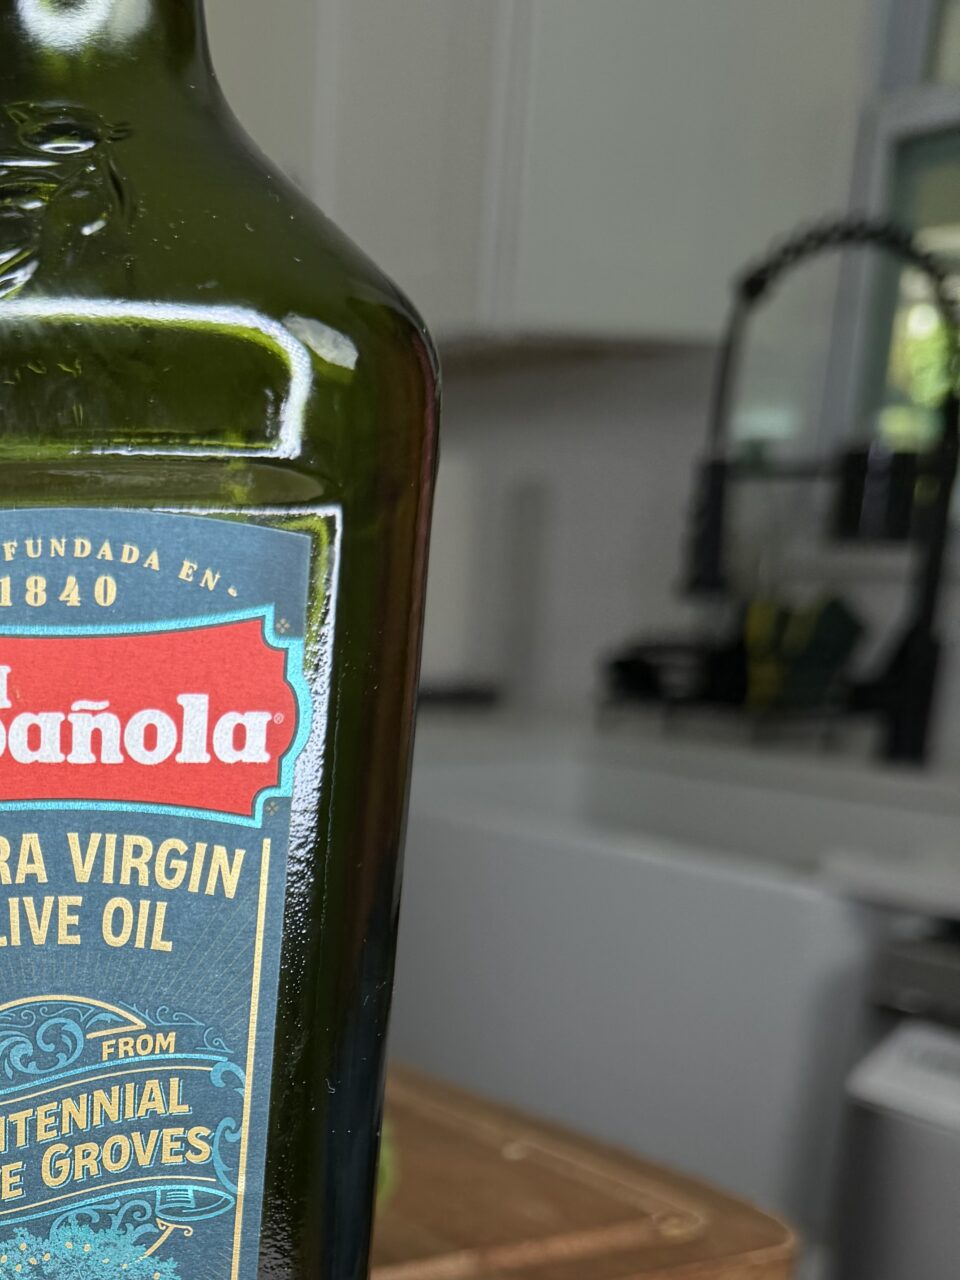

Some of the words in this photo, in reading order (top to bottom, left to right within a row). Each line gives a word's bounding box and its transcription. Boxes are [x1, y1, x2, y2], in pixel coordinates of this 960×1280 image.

[2, 536, 161, 572] FUNDADA
[178, 559, 221, 591] EN
[67, 833, 246, 899] VIRGIN
[101, 897, 173, 953] OIL
[101, 1032, 177, 1061] FROM
[41, 1126, 214, 1190] GROVES
